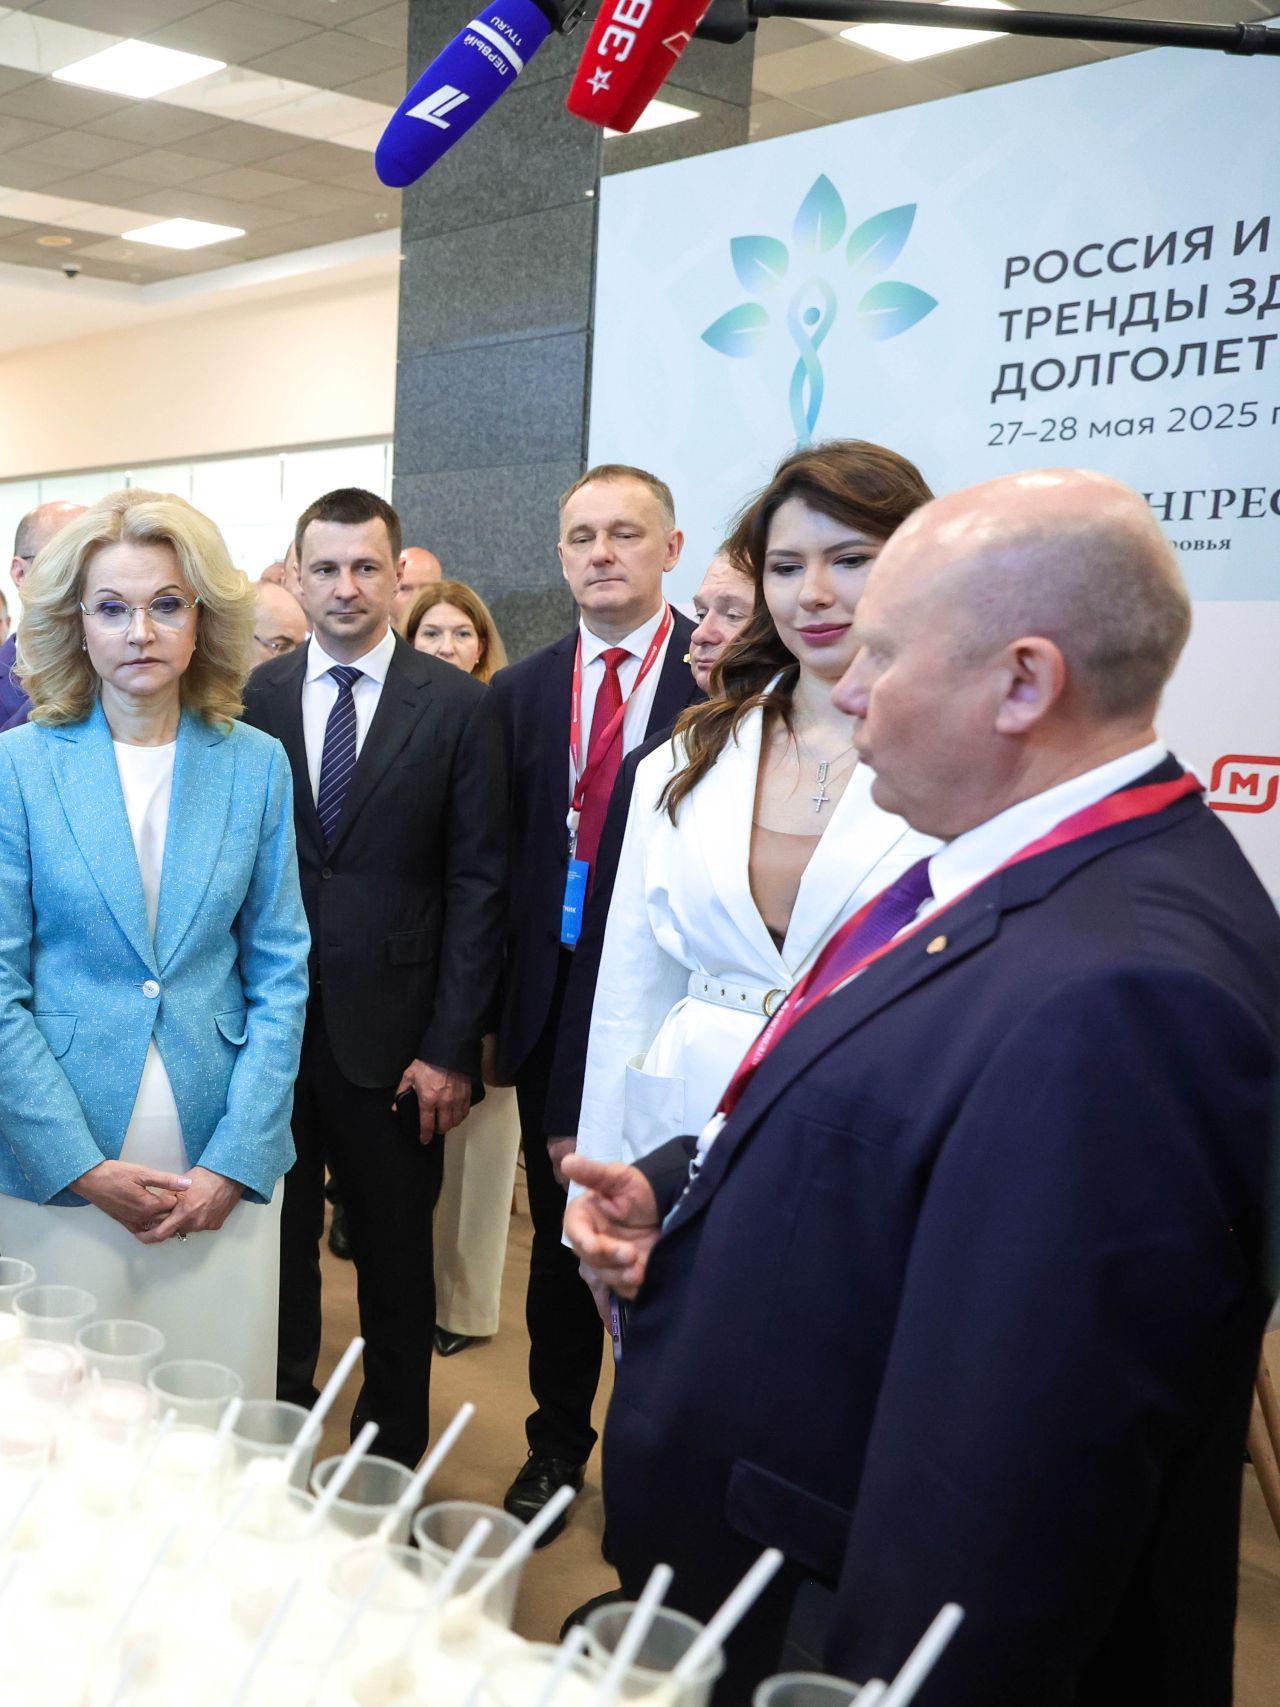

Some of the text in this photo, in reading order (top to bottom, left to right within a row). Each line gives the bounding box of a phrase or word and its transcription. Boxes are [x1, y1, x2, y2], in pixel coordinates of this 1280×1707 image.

[463, 33, 509, 76] ПЕРВЫЙ
[490, 16, 523, 46] 1TV.RU
[1004, 215, 1271, 289] РОССИЯ И
[998, 284, 1209, 343] ТРЕНДЫ
[990, 333, 1278, 404] ДОЛГОЛЕТ
[1088, 416, 1156, 439] мая
[1167, 401, 1259, 432] 2025
